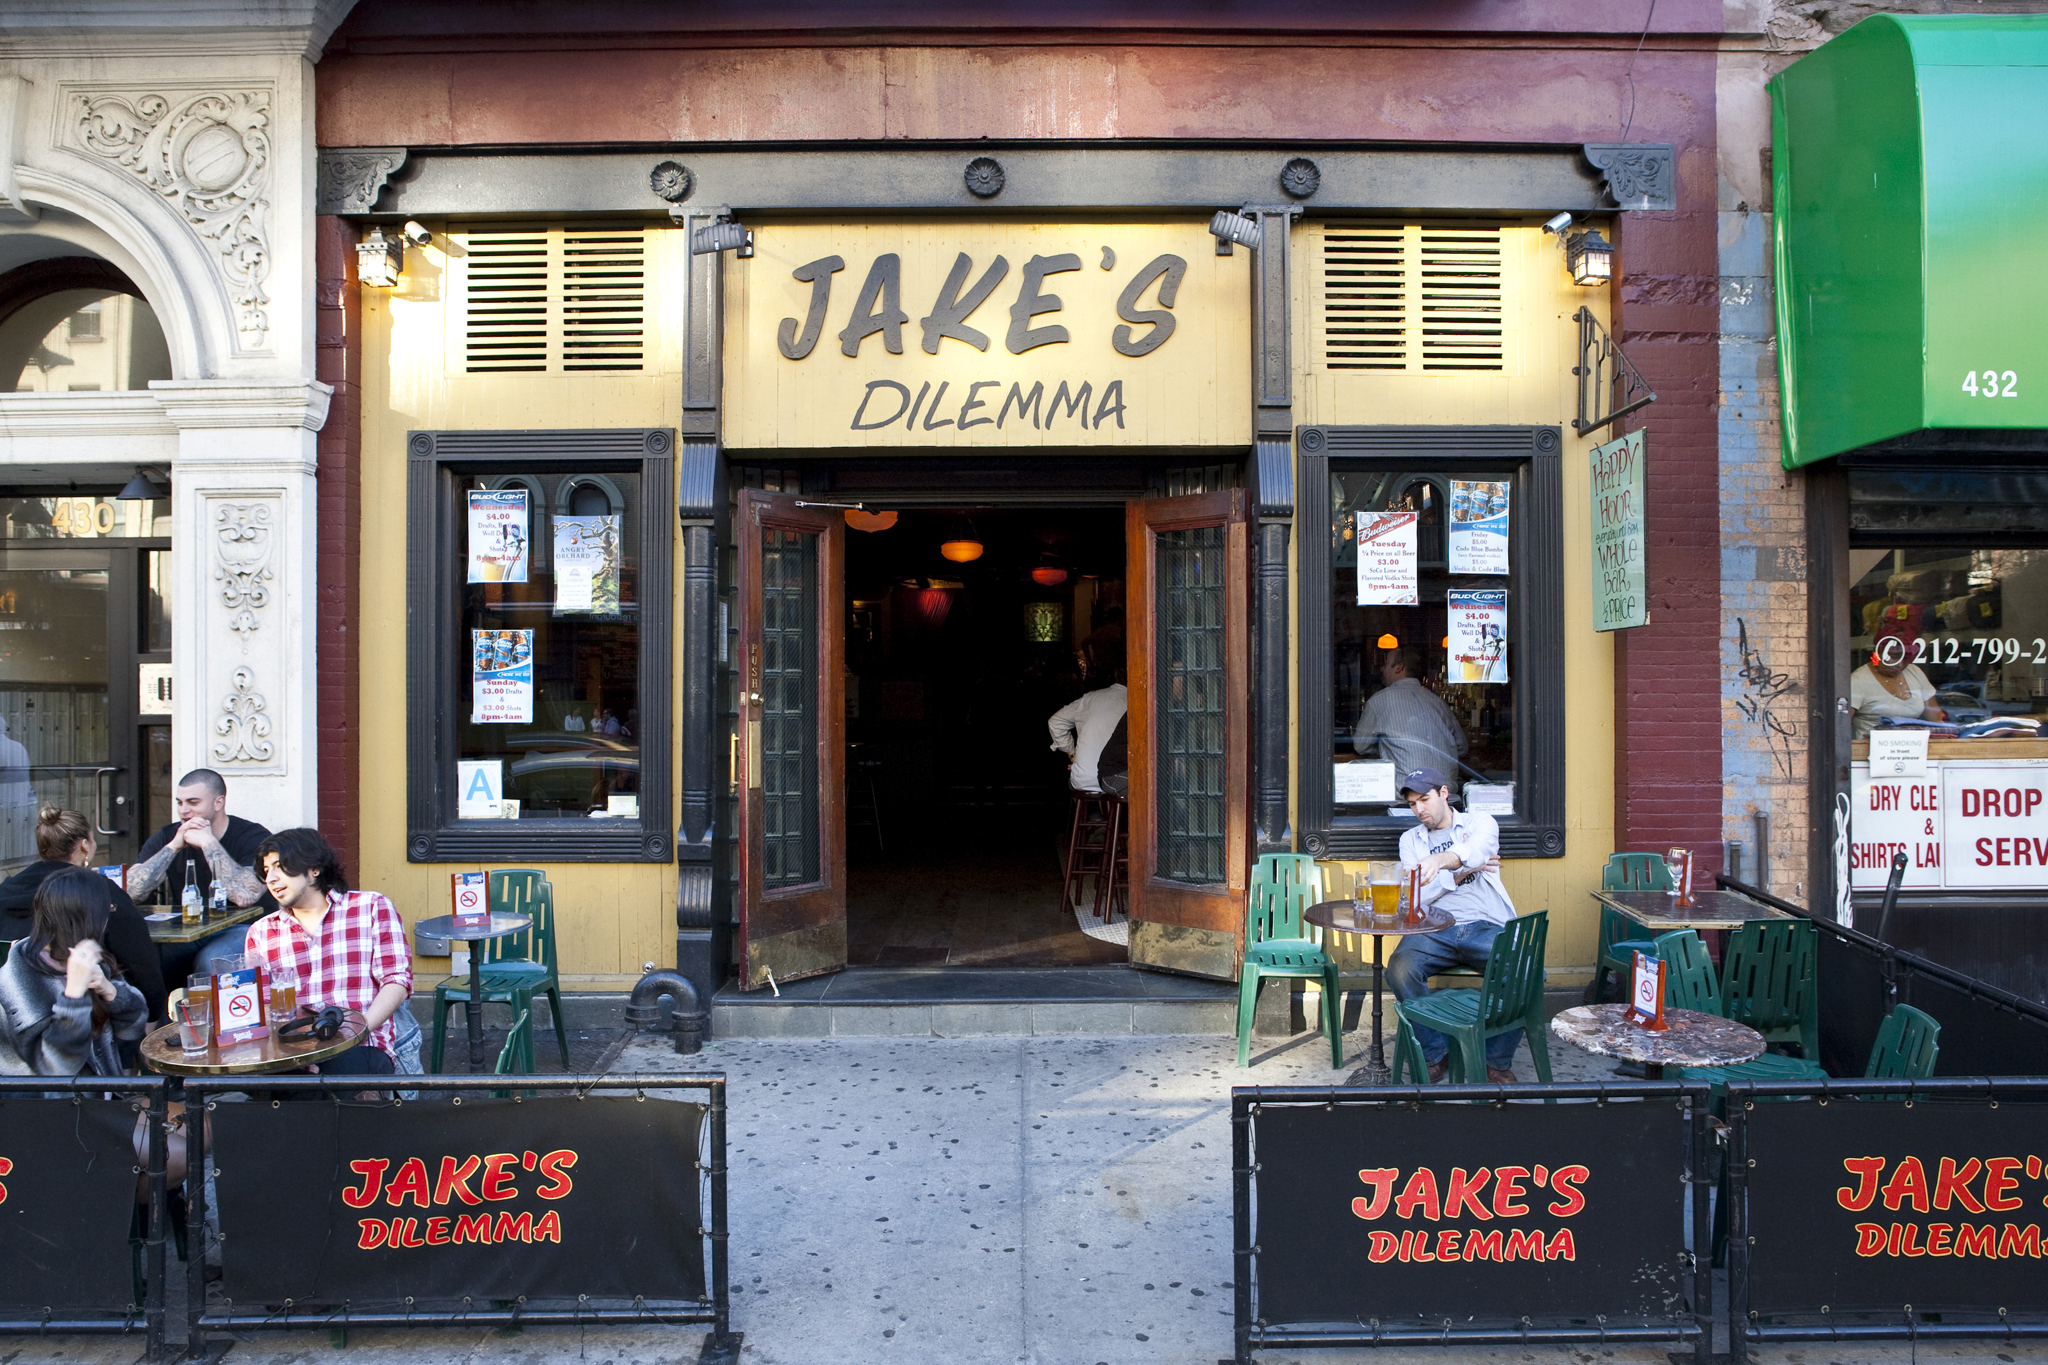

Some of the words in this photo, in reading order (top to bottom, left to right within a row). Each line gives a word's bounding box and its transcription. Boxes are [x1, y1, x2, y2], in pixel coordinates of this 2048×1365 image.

[777, 246, 1188, 361] JAKE'S
[1962, 370, 2018, 398] 432
[850, 380, 1127, 431] DILEMMA
[52, 502, 115, 534] 430
[1599, 489, 1636, 529] HOUR
[1359, 514, 1410, 542] Budweiser
[1368, 583, 1409, 591] 8pm-4am
[1450, 603, 1504, 611] Wednesday
[1455, 654, 1500, 662] 8pm-4am
[1911, 637, 2047, 665] 212-799-2
[466, 769, 494, 800] A
[1870, 785, 1901, 811] DRY
[1962, 788, 2043, 817] DROP
[1924, 818, 1934, 835] &
[343, 1149, 578, 1209] JAKE'S
[1352, 1164, 1590, 1221] JAKE'S
[1837, 1155, 2048, 1214] JAKE'
[357, 1210, 562, 1250] DILEMMA
[1367, 1227, 1575, 1263] DILEMMA
[1855, 1222, 2048, 1259] DILEMM
